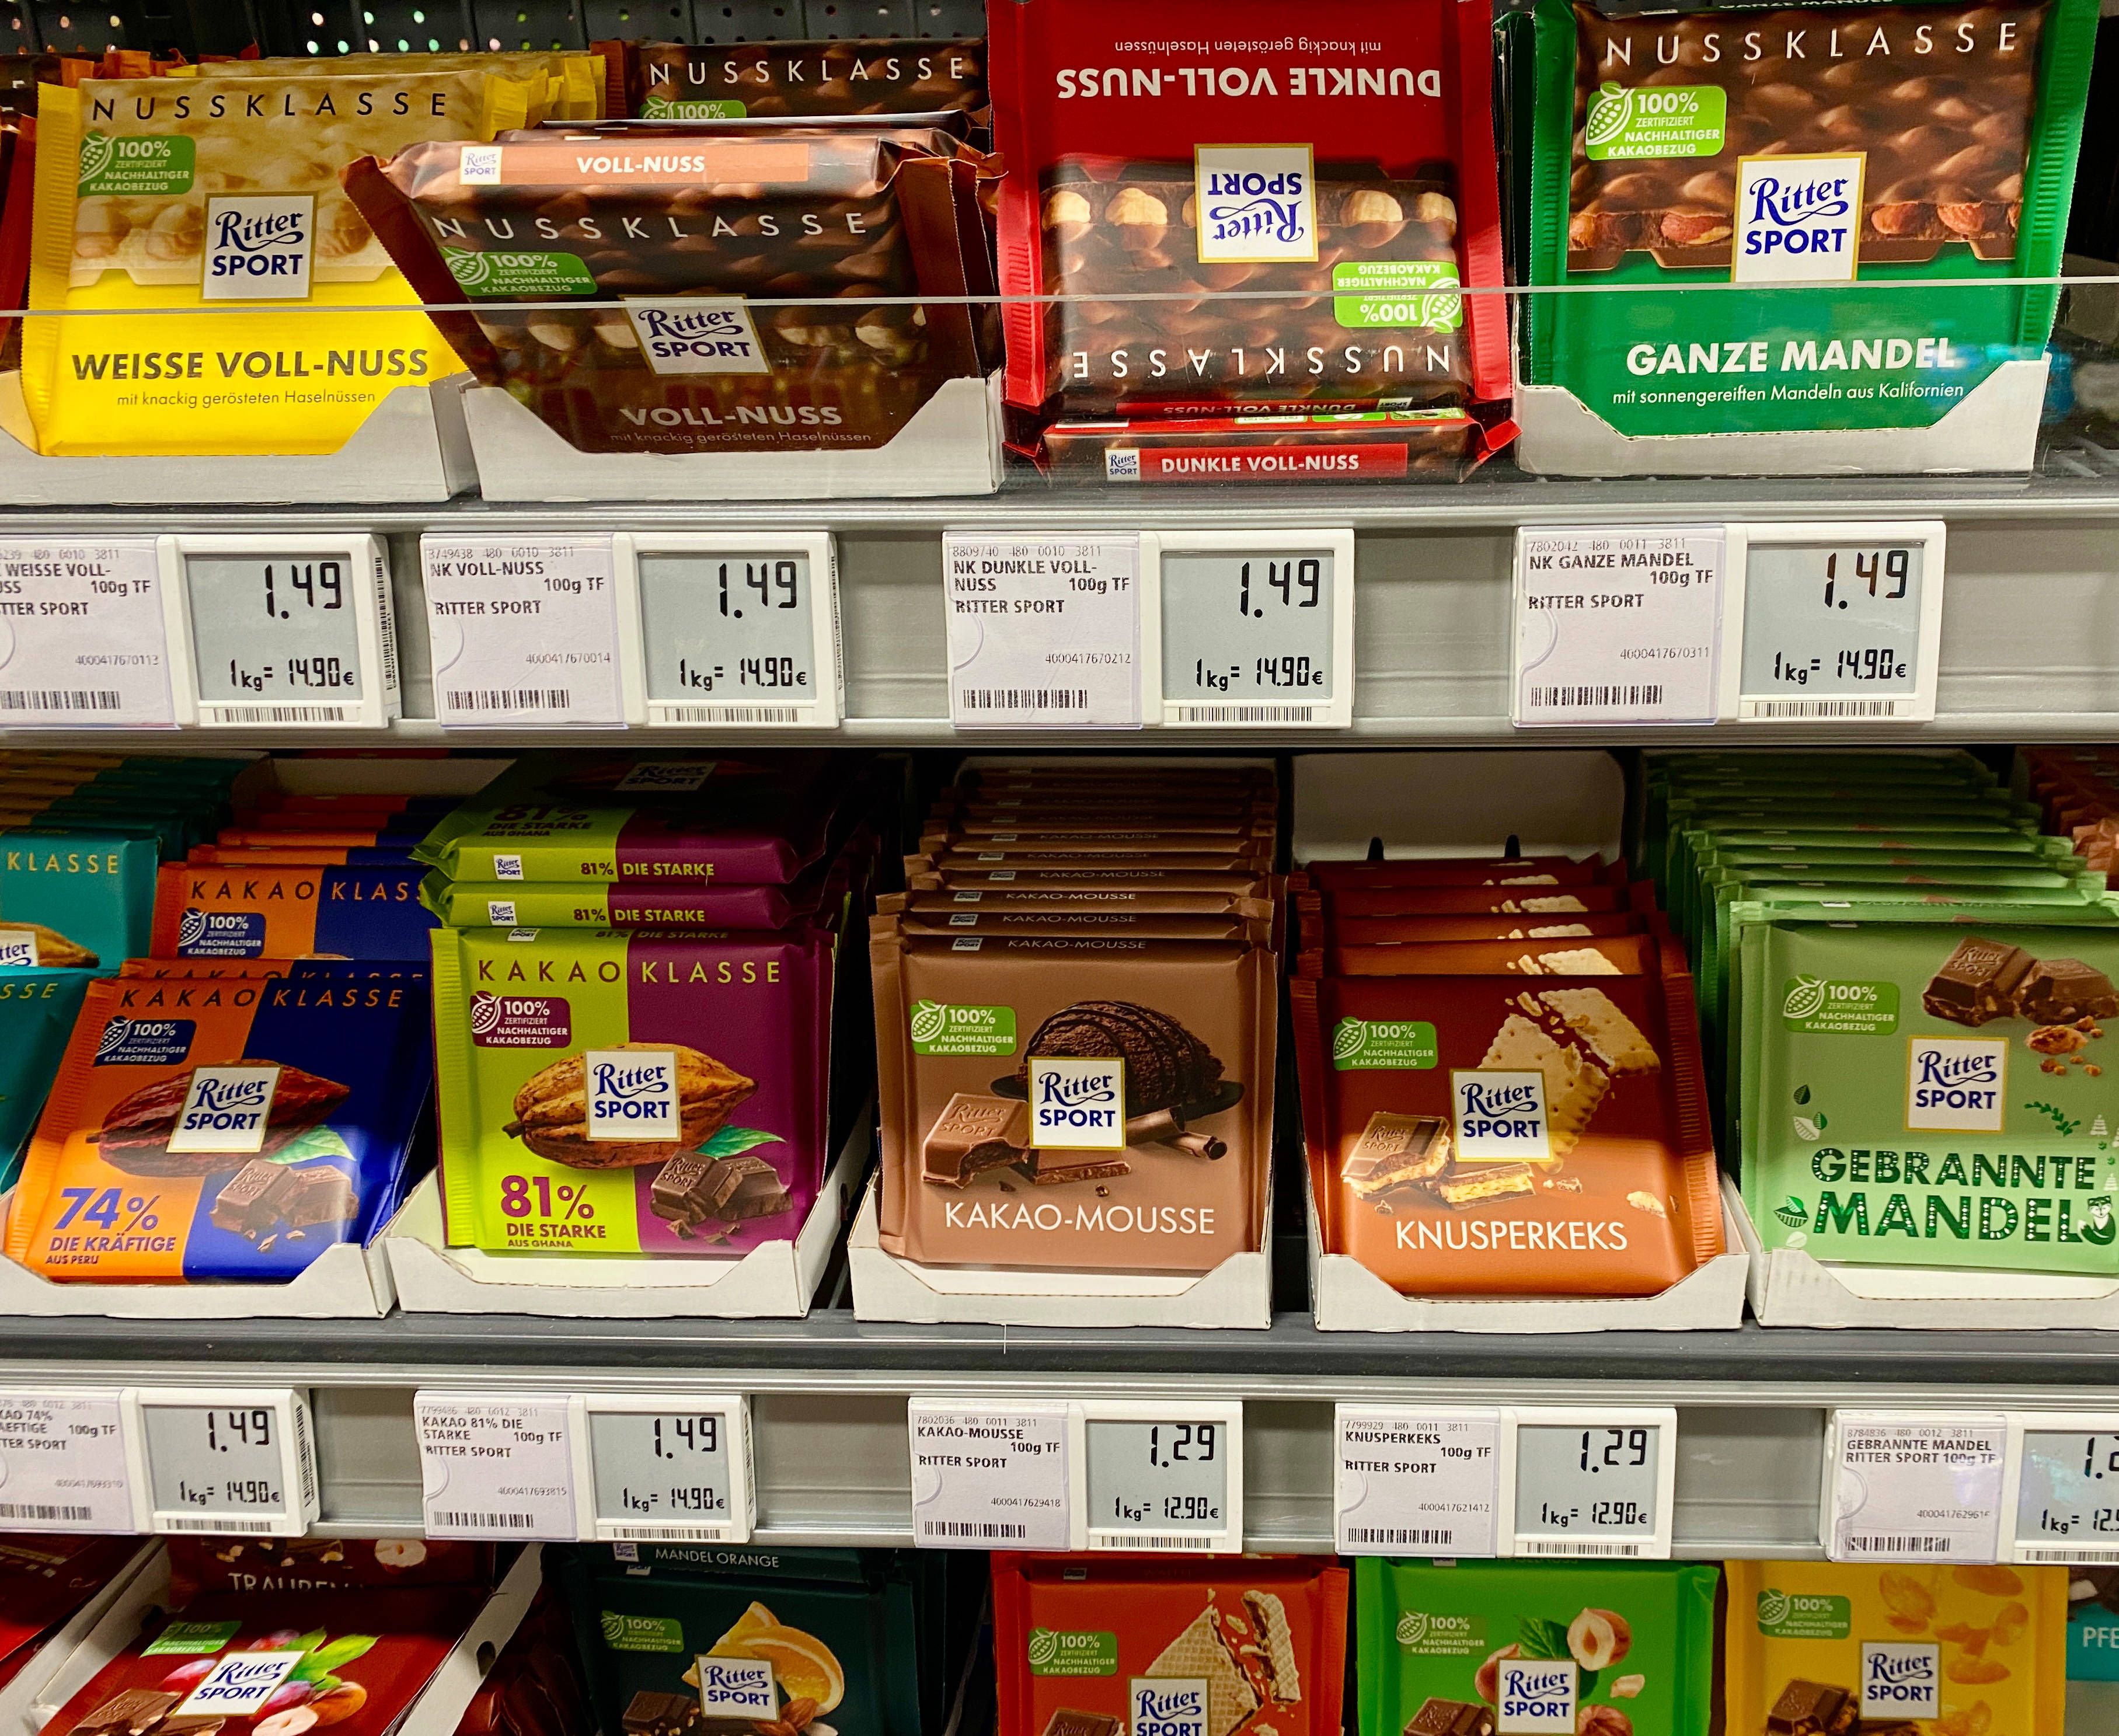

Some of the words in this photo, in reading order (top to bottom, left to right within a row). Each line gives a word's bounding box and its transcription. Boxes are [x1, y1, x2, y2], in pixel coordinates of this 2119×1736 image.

[1115, 38, 1209, 54] Haselnüssen
[1214, 38, 1294, 55] gerösteten
[1299, 38, 1356, 55] knackig
[1361, 40, 1381, 53] mit
[1606, 23, 2016, 66] NUSSKLASSE
[650, 57, 963, 86] NUSSKLASSE
[1057, 68, 1277, 99] VOLL-NUSS
[1290, 70, 1440, 97] DUNKLE
[93, 93, 445, 120] NUSSKLASSE
[1637, 93, 1699, 113] 100%
[1636, 116, 1694, 127] ZERTIFIZIERT
[1625, 129, 1720, 142] NACHHALTIGER
[118, 142, 170, 158] 100%
[1608, 144, 1696, 156] KAKAOBEZUG
[577, 156, 705, 173] VOLL-NUSS
[1208, 172, 1301, 195] SPORT
[1749, 176, 1849, 225] Ritter
[430, 213, 866, 240] NUSSKLASSE
[1210, 198, 1304, 242] Ritter
[215, 211, 304, 252] Ritter
[1745, 228, 1846, 254] SPORT
[212, 255, 302, 276] SPORT
[492, 255, 557, 268] 100%
[638, 309, 745, 339] Ritter
[653, 342, 750, 358] SPORT
[1627, 343, 1768, 375] GANZE
[1781, 337, 1954, 371] MANDEL
[72, 352, 203, 379] WEISSE
[217, 350, 428, 378] VOLL-NUSS
[1075, 346, 1449, 378] NUSSKLASSE
[117, 393, 138, 405] mit
[142, 392, 197, 408] knackig
[203, 392, 279, 407] gerösteten
[284, 391, 375, 405] Haselnüssen
[1613, 391, 1636, 405] mit
[1640, 386, 1766, 406] sonnengereiften
[1771, 385, 1842, 400] Mandeln
[1846, 386, 1873, 398] aus
[1878, 383, 1963, 398] Kalifornien
[619, 406, 842, 426] VOLL-NUSS
[1162, 458, 1240, 472] DUNKLE
[1249, 455, 1358, 470] VOLL-NUSS
[7, 564, 61, 576] WEISSE
[67, 564, 111, 576] VOLL-
[430, 564, 452, 576] NK
[456, 562, 544, 576] VOLL-NUSS
[954, 562, 976, 574] NK
[982, 561, 1045, 574] DUNKLE
[1050, 560, 1097, 574] VOLL-
[1529, 556, 1552, 570] NK
[1559, 555, 1615, 569] GANZE
[1621, 553, 1693, 567] MANDEL
[544, 578, 581, 594] 100g
[587, 578, 604, 590] TF
[955, 578, 996, 591] NUSS
[1069, 577, 1107, 594] 100g
[1112, 578, 1130, 591] TF
[1650, 570, 1690, 587] 100g
[1696, 571, 1713, 583] TF
[1824, 550, 1908, 610] 1.49
[91, 580, 127, 596] 100g
[133, 581, 151, 594] TF
[264, 562, 342, 619] 1.49
[719, 562, 796, 618] 1.49
[1240, 560, 1320, 618] 1.49
[40, 602, 89, 615] SPORT
[435, 602, 485, 615] RITTER
[490, 601, 541, 614] SPORT
[956, 600, 1007, 613] RITTER
[1015, 599, 1064, 613] SPORT
[1528, 595, 1583, 609] RITTER
[1590, 594, 1644, 608] SPORT
[580, 863, 614, 875] 81%
[622, 863, 649, 875] DIE
[651, 863, 715, 876] STARKE
[191, 881, 315, 900] KAKAO
[573, 909, 606, 921] 81%
[615, 909, 642, 922] DIE
[644, 909, 705, 922] STARKE
[1008, 939, 1146, 949] KAKAO-MOUSSE
[478, 960, 621, 982] KAKAO
[642, 961, 780, 983] KLASSE
[120, 989, 256, 1008] KAKAO
[273, 989, 403, 1009] KLASSE
[1828, 985, 1877, 1001] 100%
[504, 1001, 550, 1015] 100%
[949, 1009, 996, 1024] 100%
[941, 1036, 1013, 1044] NACHHALTIGER
[1371, 1025, 1416, 1038] 100%
[929, 1044, 997, 1052] KAKAOBEZUG
[1918, 1050, 1996, 1086] Ritter
[594, 1063, 667, 1098] Ritter
[191, 1078, 268, 1111] Ritter
[1039, 1072, 1115, 1107] Ritter
[1461, 1083, 1538, 1117] Ritter
[1916, 1090, 1996, 1109] SPORT
[594, 1101, 670, 1118] SPORT
[184, 1113, 260, 1131] SPORT
[1040, 1110, 1116, 1127] SPORT
[1463, 1120, 1540, 1138] SPORT
[1811, 1148, 2095, 1190] GEBRANNTE
[501, 1176, 594, 1219] 81%
[54, 1188, 159, 1231] 74%
[945, 1203, 1215, 1235] KAKAO-MOUSSE
[507, 1223, 536, 1237] DIE
[539, 1224, 606, 1238] STARKE
[1396, 1221, 1628, 1250] KNUSPERKEKS
[50, 1237, 81, 1250] DIE
[85, 1233, 176, 1251] KRÄFTIGE
[507, 1239, 529, 1247] AUS
[532, 1240, 573, 1248] GHANA
[71, 1255, 98, 1264] PERU
[208, 1410, 269, 1452] 1.49
[422, 1417, 467, 1427] KAKAO
[471, 1418, 497, 1428] 81%
[502, 1419, 522, 1429] DIE
[424, 1430, 471, 1439] STARKE
[514, 1431, 544, 1444] 100g
[548, 1432, 562, 1442] TF
[655, 1417, 717, 1459] 1.49
[918, 1428, 1023, 1439] KAKAO-MOUSSE
[1346, 1432, 1441, 1444] KNUSPERKEKS
[1010, 1442, 1041, 1454] 100g
[1045, 1442, 1060, 1452] TF
[1151, 1425, 1214, 1467] 1.29
[1441, 1446, 1472, 1459] 100g
[1476, 1447, 1490, 1457] TF
[1581, 1430, 1646, 1473] 1.29
[1848, 1439, 1928, 1450] GEBRANNTE
[1932, 1439, 1991, 1451] MANDEL
[919, 1455, 961, 1466] RITTER
[966, 1457, 1007, 1468] SPORT
[1346, 1460, 1389, 1472] RITTER
[1394, 1462, 1436, 1473] SPORT
[1846, 1452, 1890, 1463] RITTER
[1896, 1453, 1938, 1464] SPORT
[1944, 1452, 1975, 1466] 100g
[1981, 1453, 1996, 1464] TF
[656, 1548, 713, 1562] MANDEL
[717, 1552, 779, 1568] ORANGE
[1868, 1653, 1933, 1683] Ritter
[705, 1665, 768, 1689] Ritter
[1504, 1669, 1570, 1700] Ritter
[194, 1686, 270, 1700] SPORT
[708, 1690, 769, 1706] SPORT
[1868, 1685, 1933, 1702] SPORT
[1136, 1690, 1201, 1721] Ritter
[1504, 1702, 1569, 1717] SPORT
